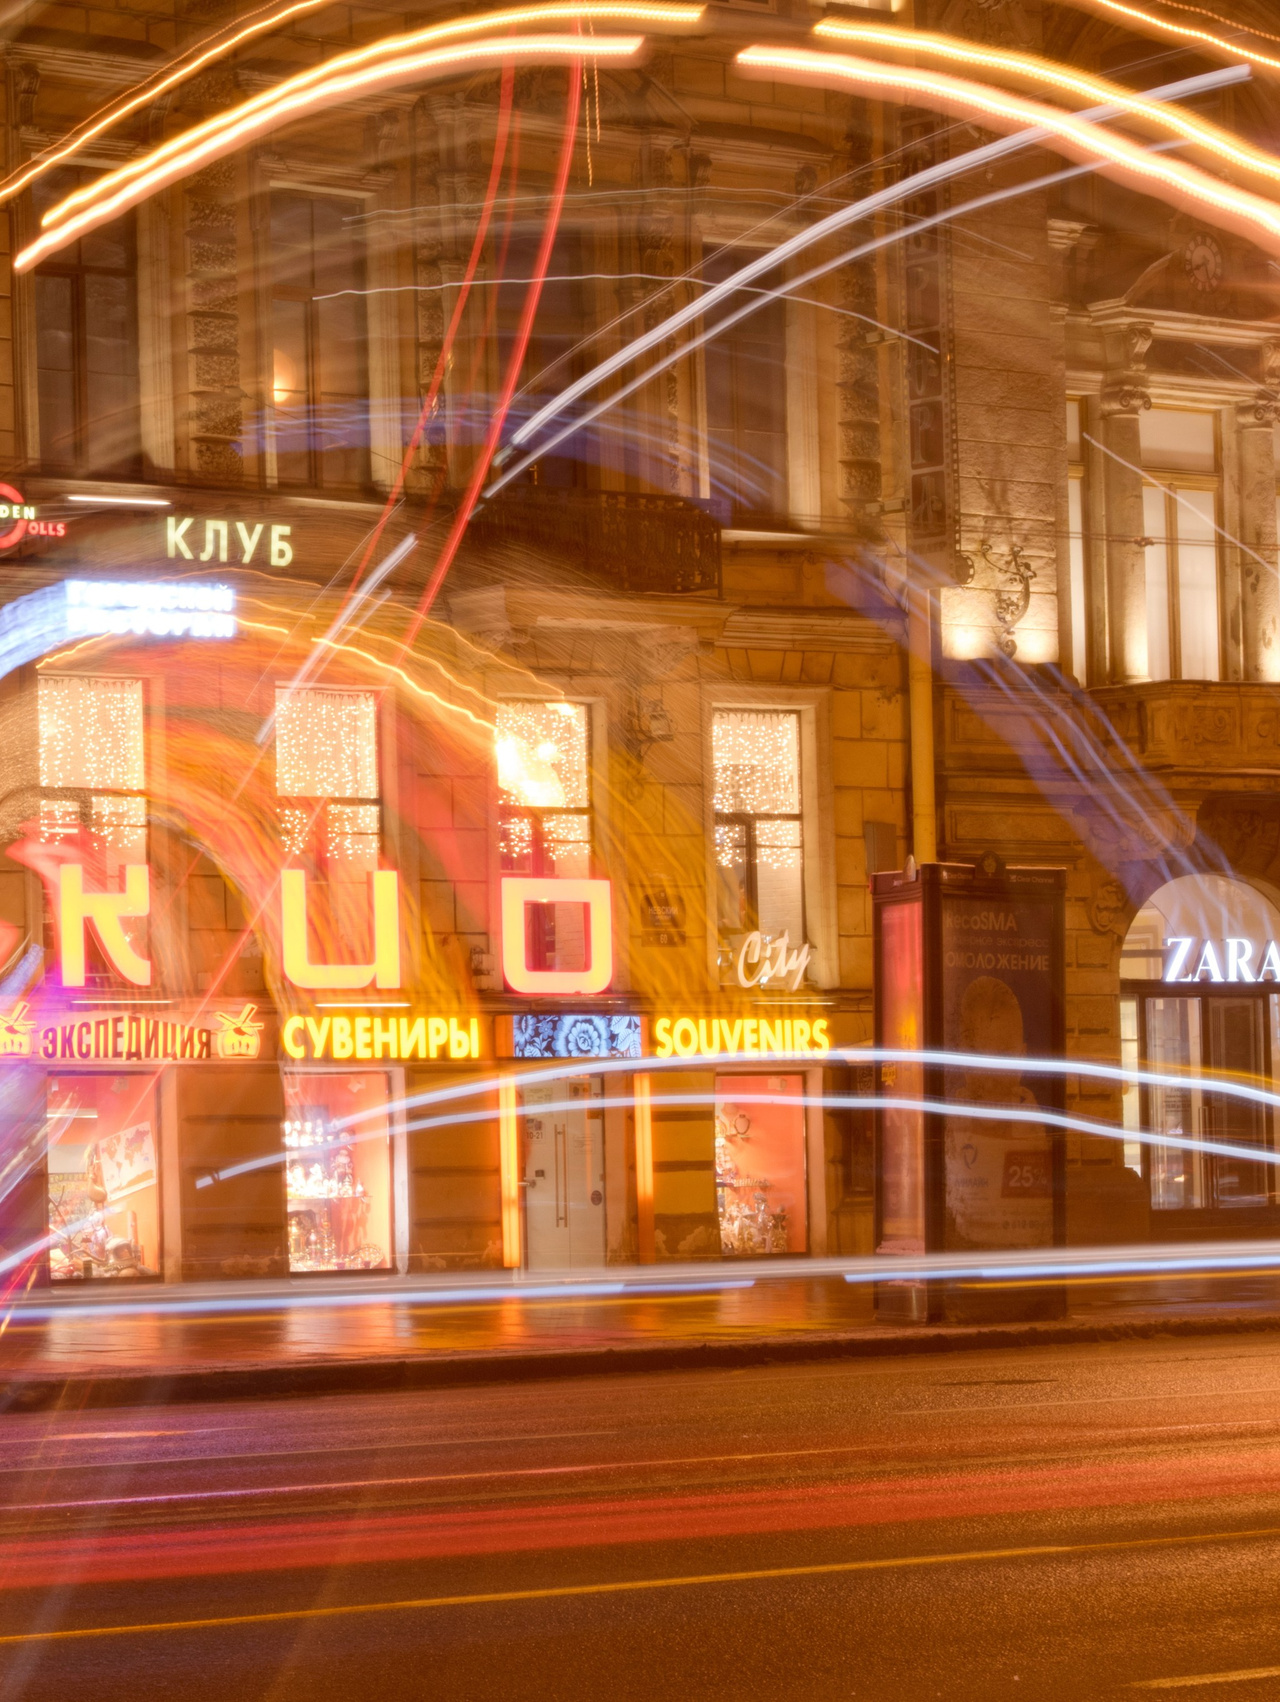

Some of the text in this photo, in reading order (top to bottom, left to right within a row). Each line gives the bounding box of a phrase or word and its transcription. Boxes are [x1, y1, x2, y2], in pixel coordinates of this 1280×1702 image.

[166, 516, 293, 567] КЛУБ
[738, 928, 811, 993] City
[944, 951, 1050, 972] ОМОЛОЖЕНИЕ
[1164, 937, 1280, 983] ZARA
[40, 1014, 212, 1061] ЭКСПЕДИЦИЯ
[283, 1015, 480, 1059] СУВЕНИРЫ
[655, 1017, 831, 1059] SOUVENIRS
[1008, 1165, 1048, 1188] 25%
